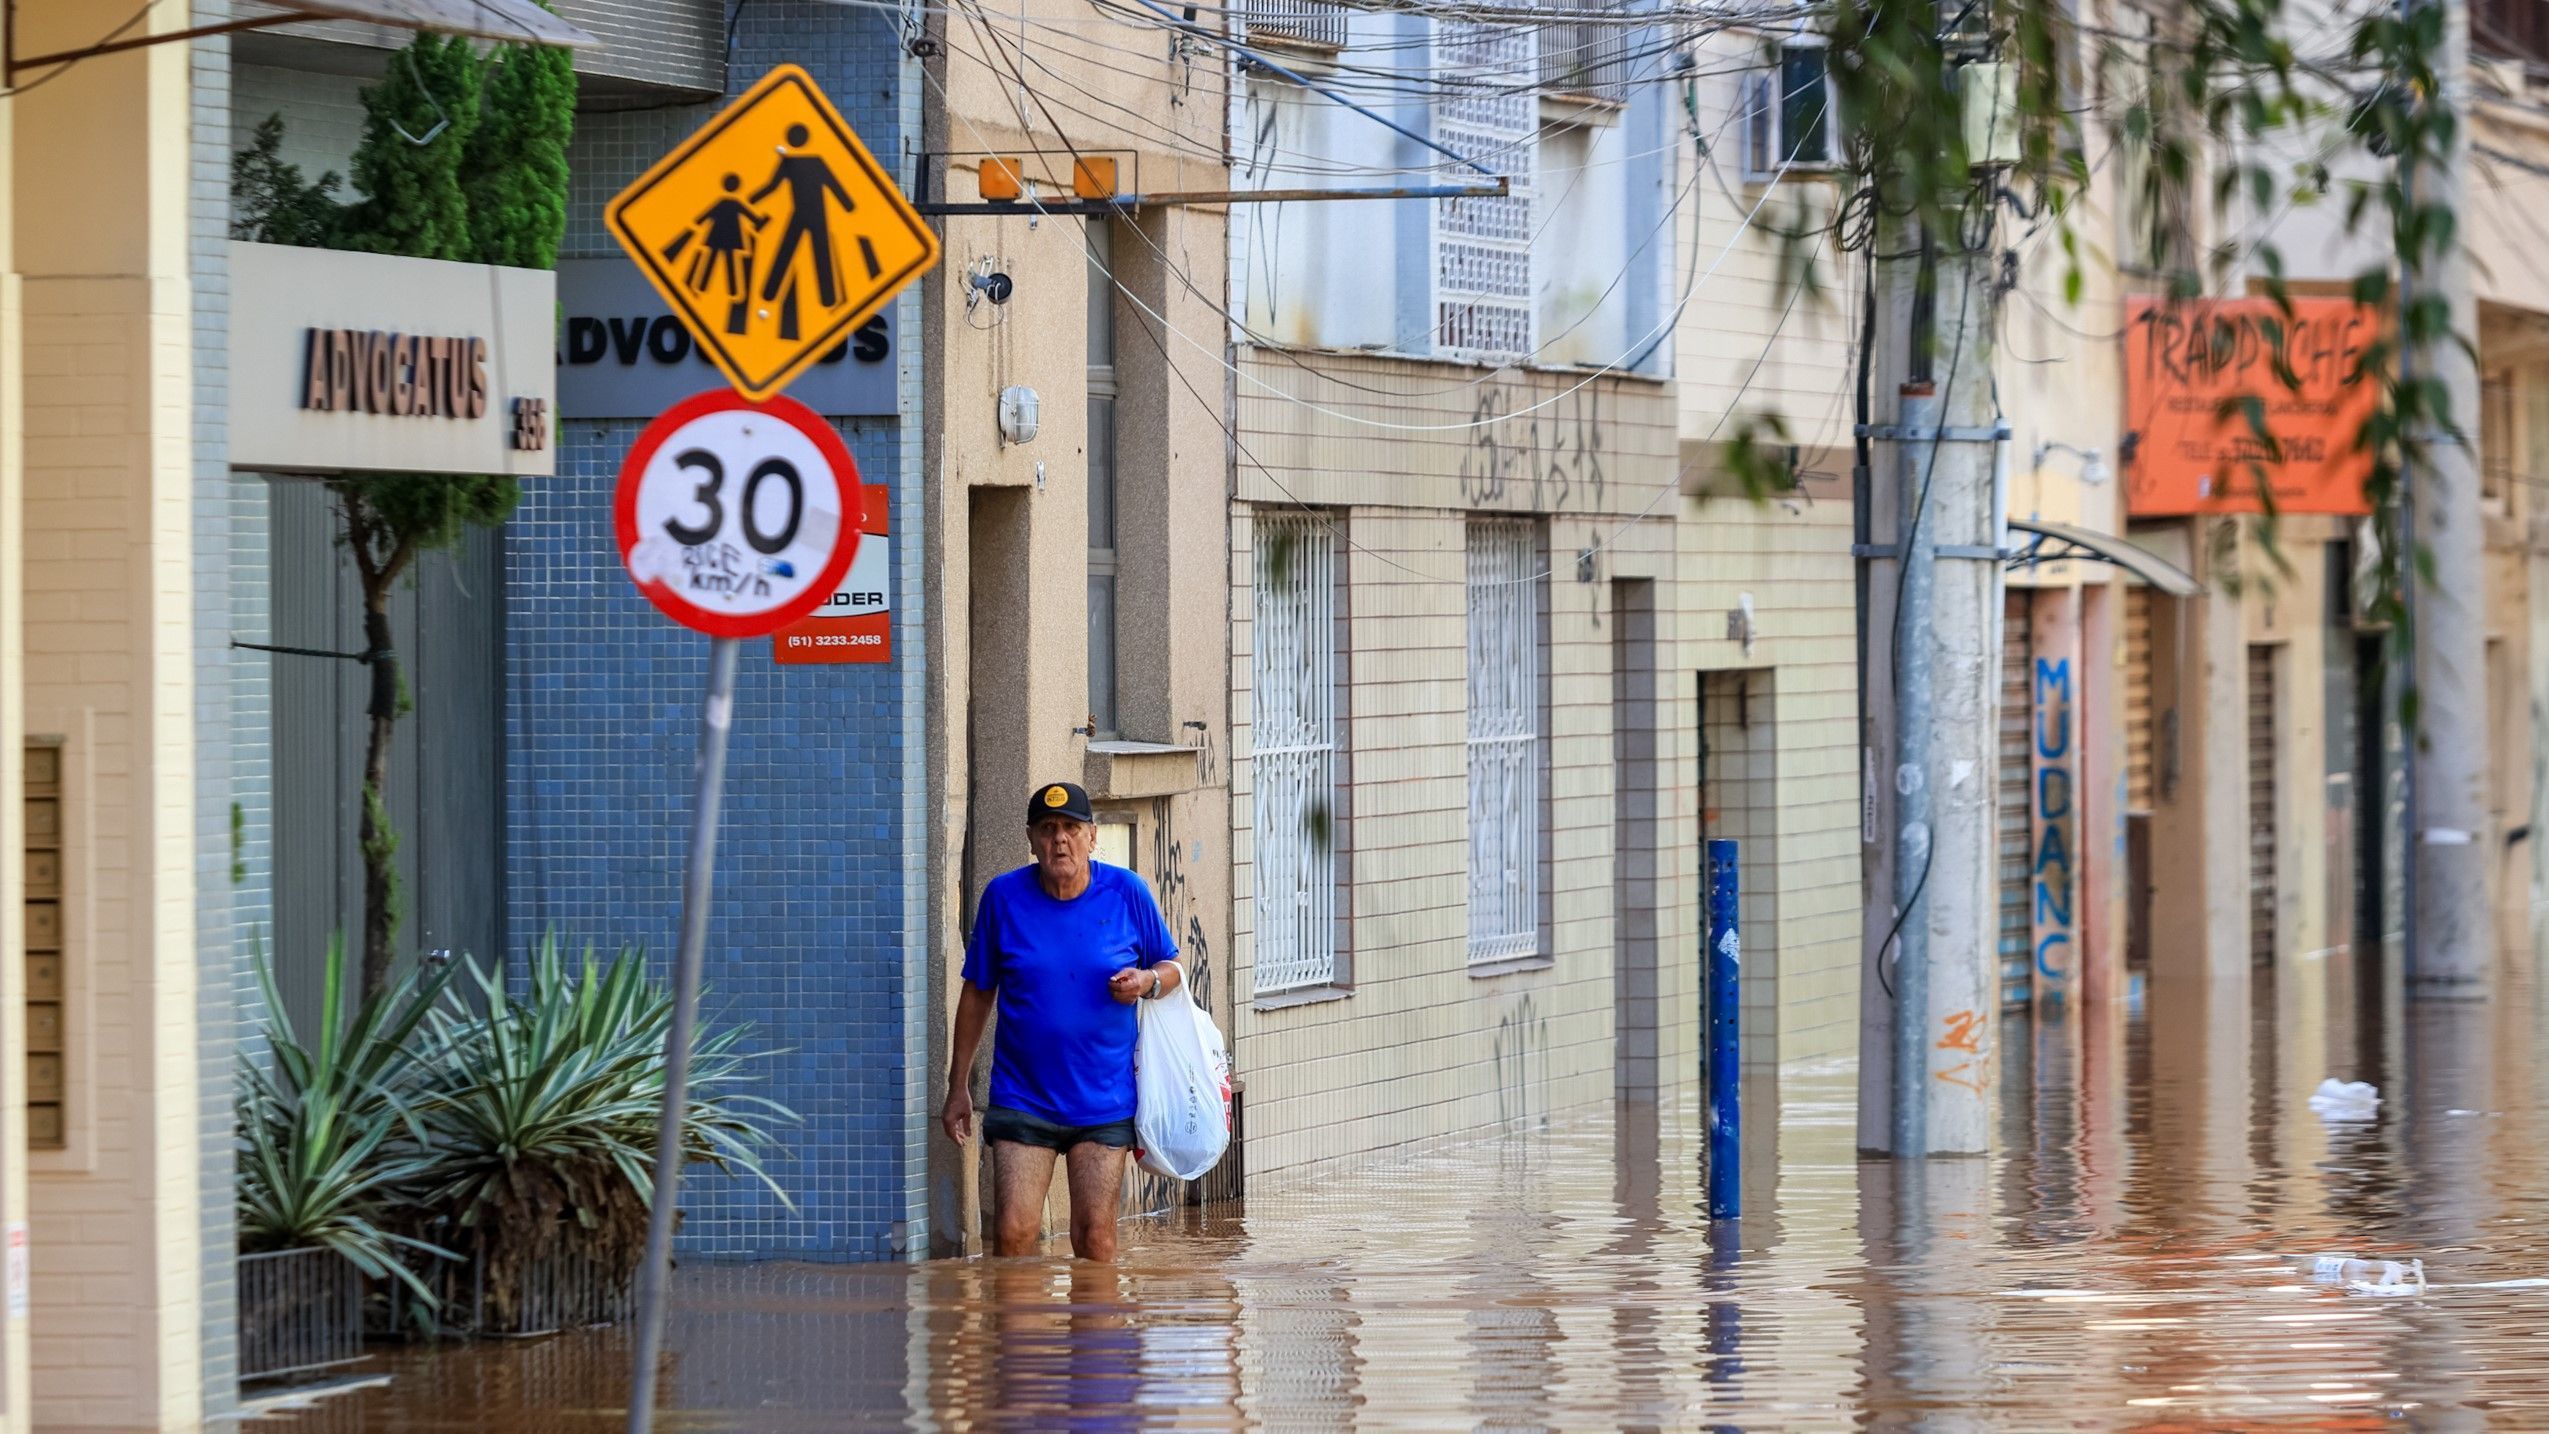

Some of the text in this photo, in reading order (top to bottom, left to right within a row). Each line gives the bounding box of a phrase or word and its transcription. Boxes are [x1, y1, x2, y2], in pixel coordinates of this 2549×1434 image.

[300, 326, 487, 419] ADVOCATUS
[663, 446, 804, 555] 30
[690, 566, 771, 597] km/h
[788, 635, 881, 647] (51) 3233.2458
